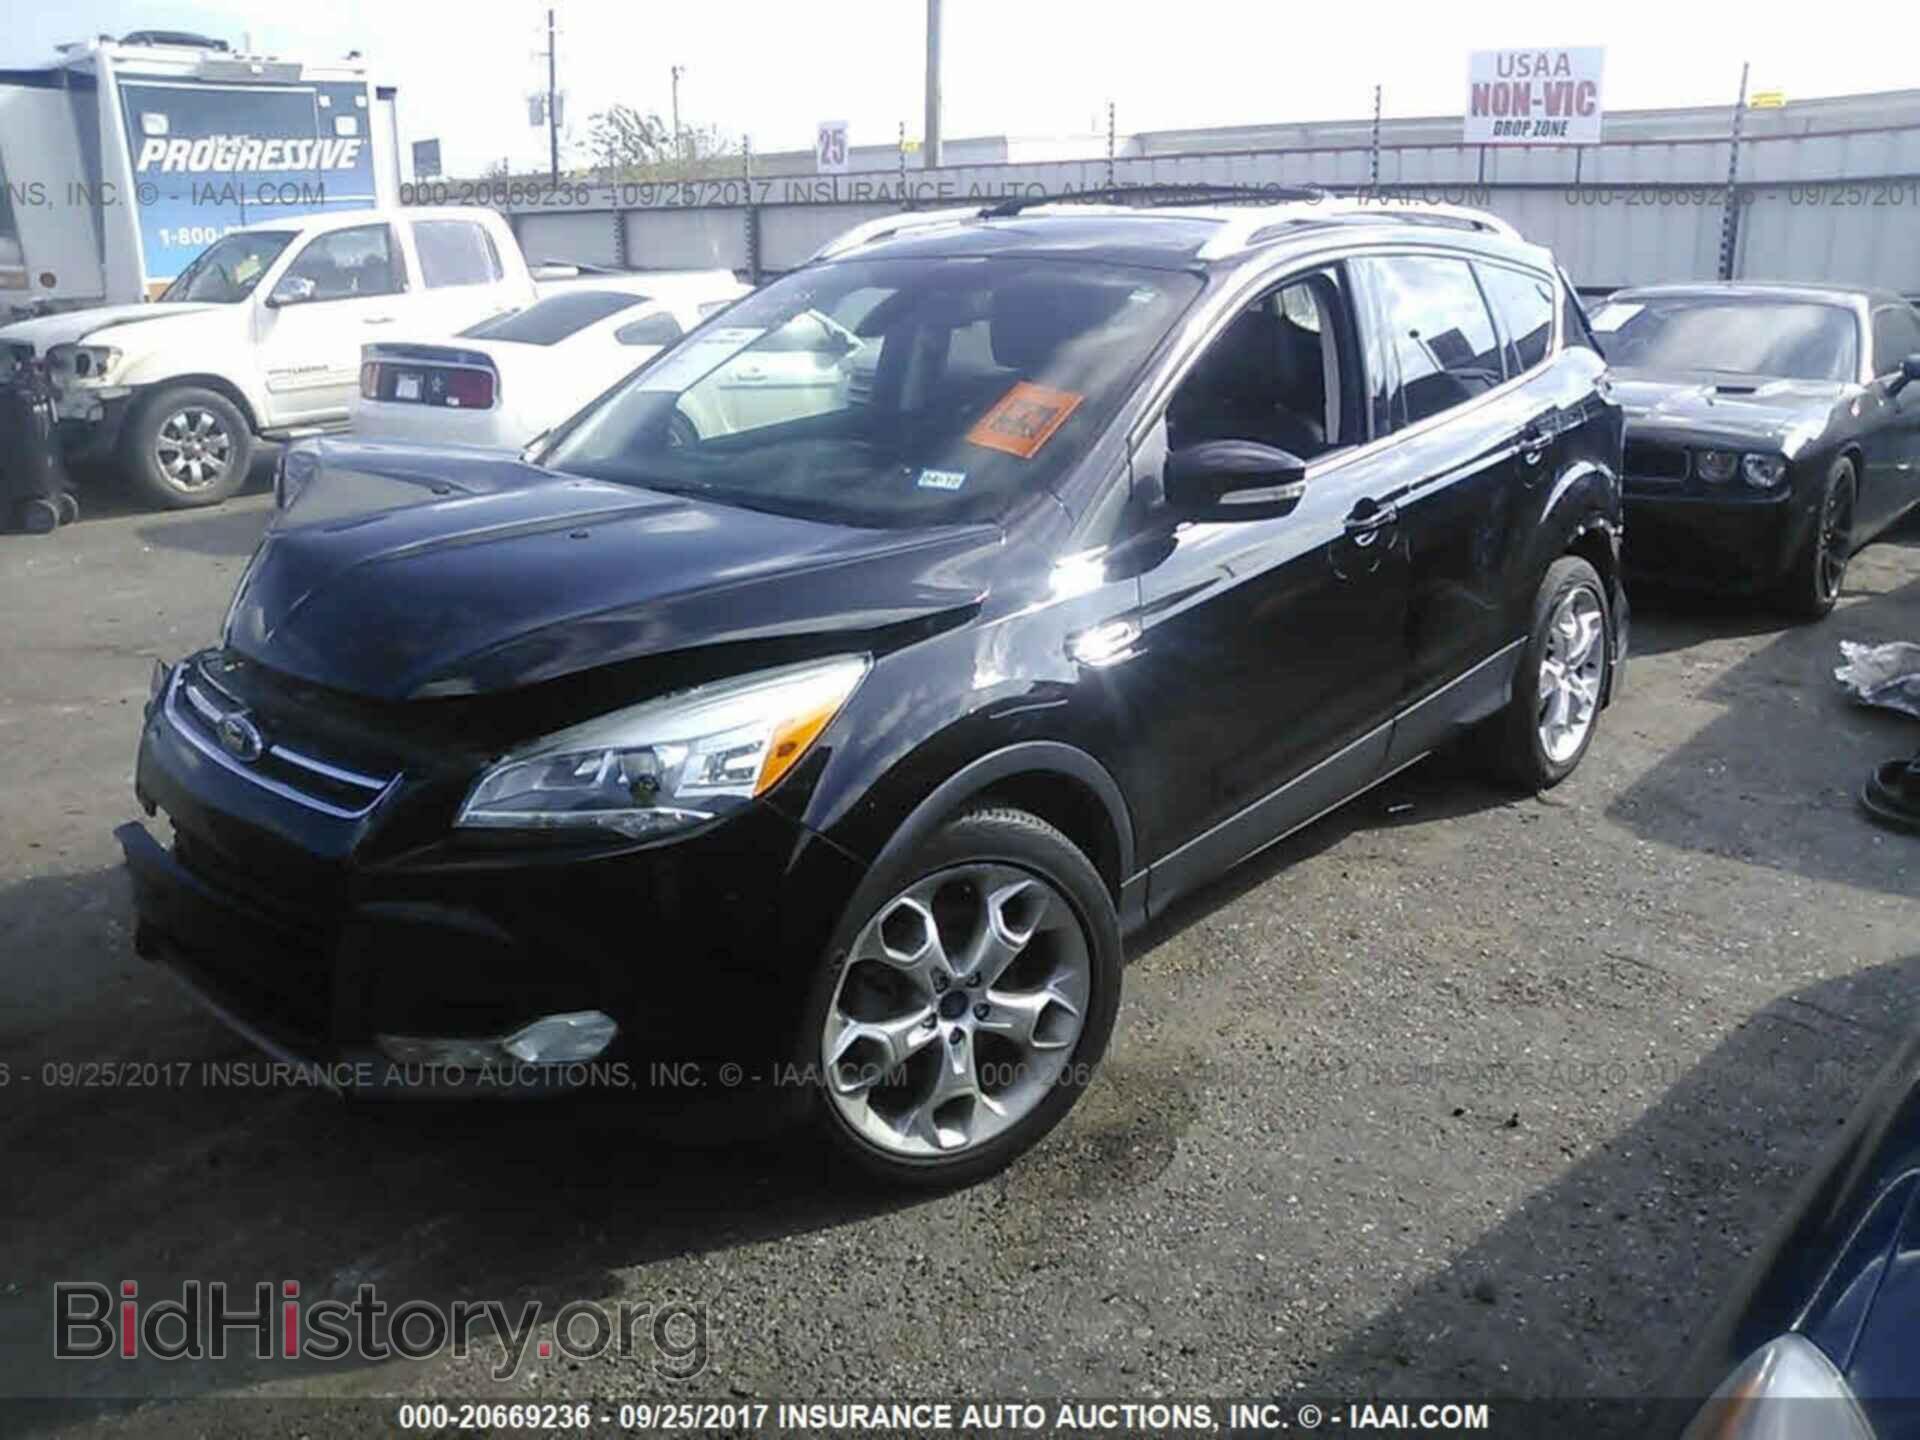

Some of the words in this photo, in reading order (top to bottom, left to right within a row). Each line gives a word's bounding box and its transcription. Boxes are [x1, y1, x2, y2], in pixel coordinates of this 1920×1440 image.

[1497, 51, 1571, 78] USAA
[1471, 80, 1597, 117] NON-VIC
[1493, 119, 1531, 137] DROP
[1533, 120, 1570, 137] ZONE
[136, 138, 361, 172] PROGRESSIVE
[820, 128, 845, 165] 25
